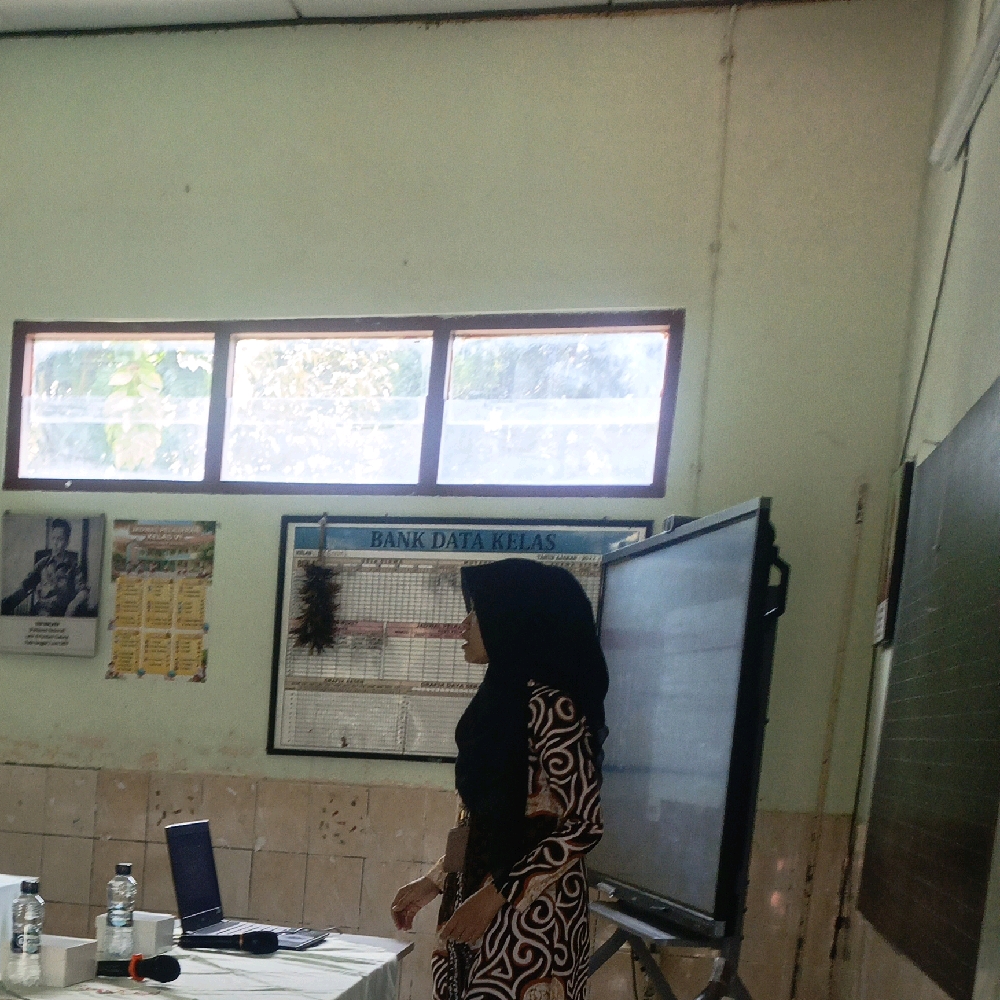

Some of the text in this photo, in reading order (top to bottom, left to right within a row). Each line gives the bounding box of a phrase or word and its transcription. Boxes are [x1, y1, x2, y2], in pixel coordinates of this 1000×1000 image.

[370, 530, 557, 551] BANK DATA KELAS
